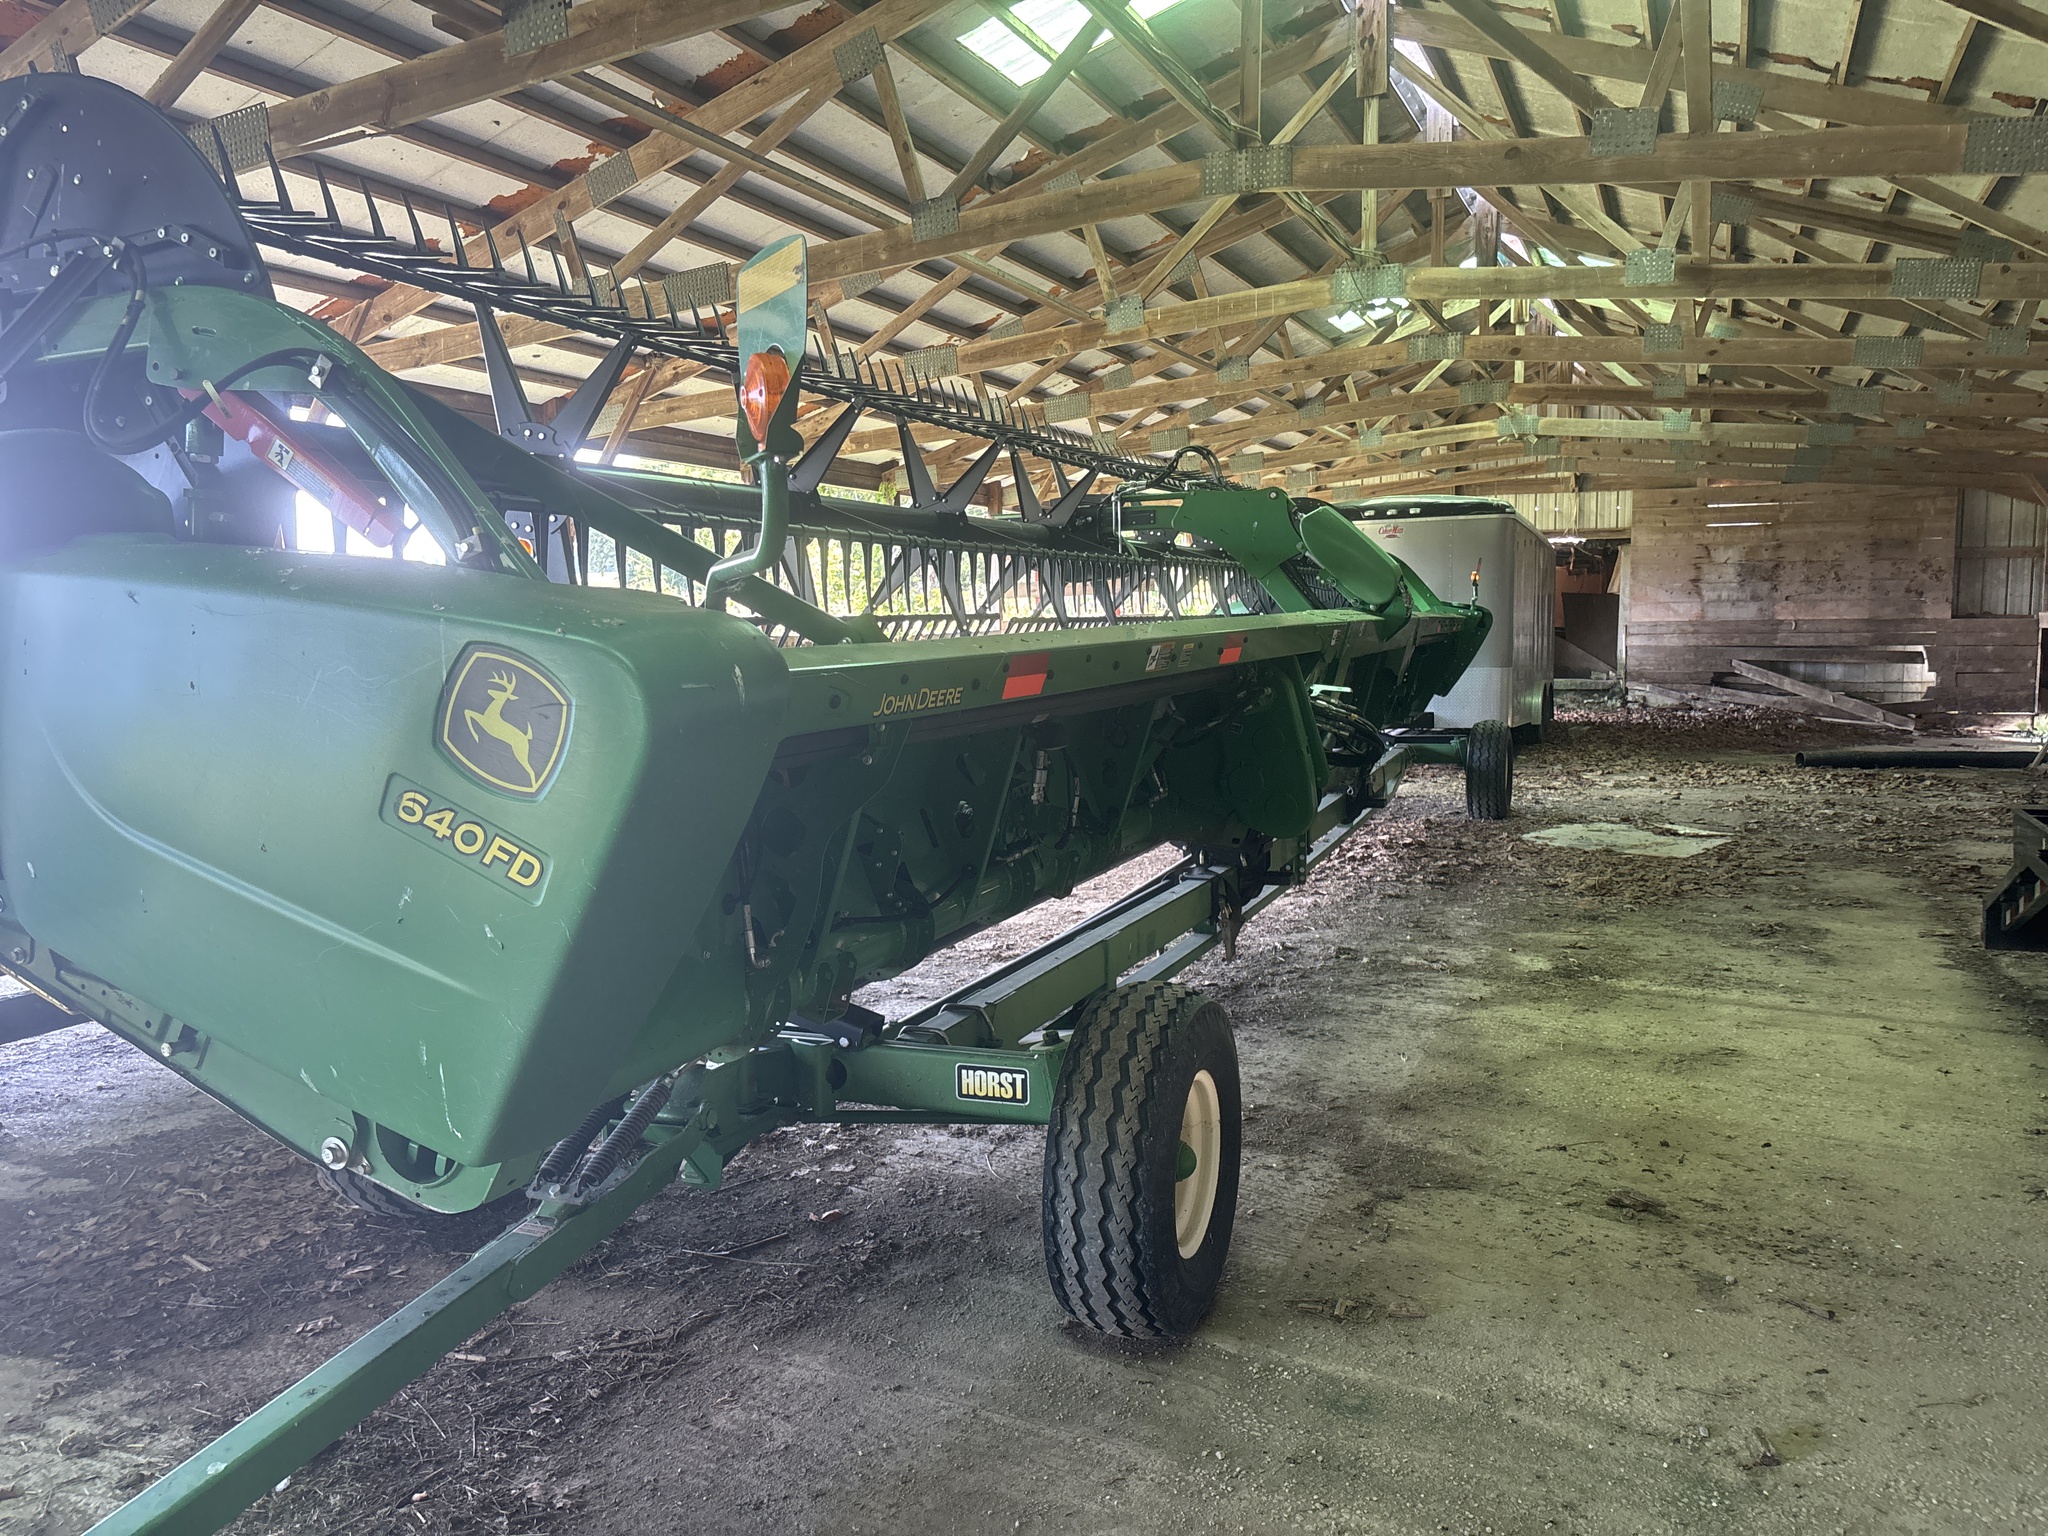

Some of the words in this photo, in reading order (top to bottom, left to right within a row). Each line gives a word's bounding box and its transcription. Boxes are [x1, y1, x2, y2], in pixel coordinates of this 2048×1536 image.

[873, 693, 917, 717] JOHN
[916, 687, 964, 710] DEERE
[397, 790, 542, 887] 640FD
[961, 1068, 1026, 1100] HORST
